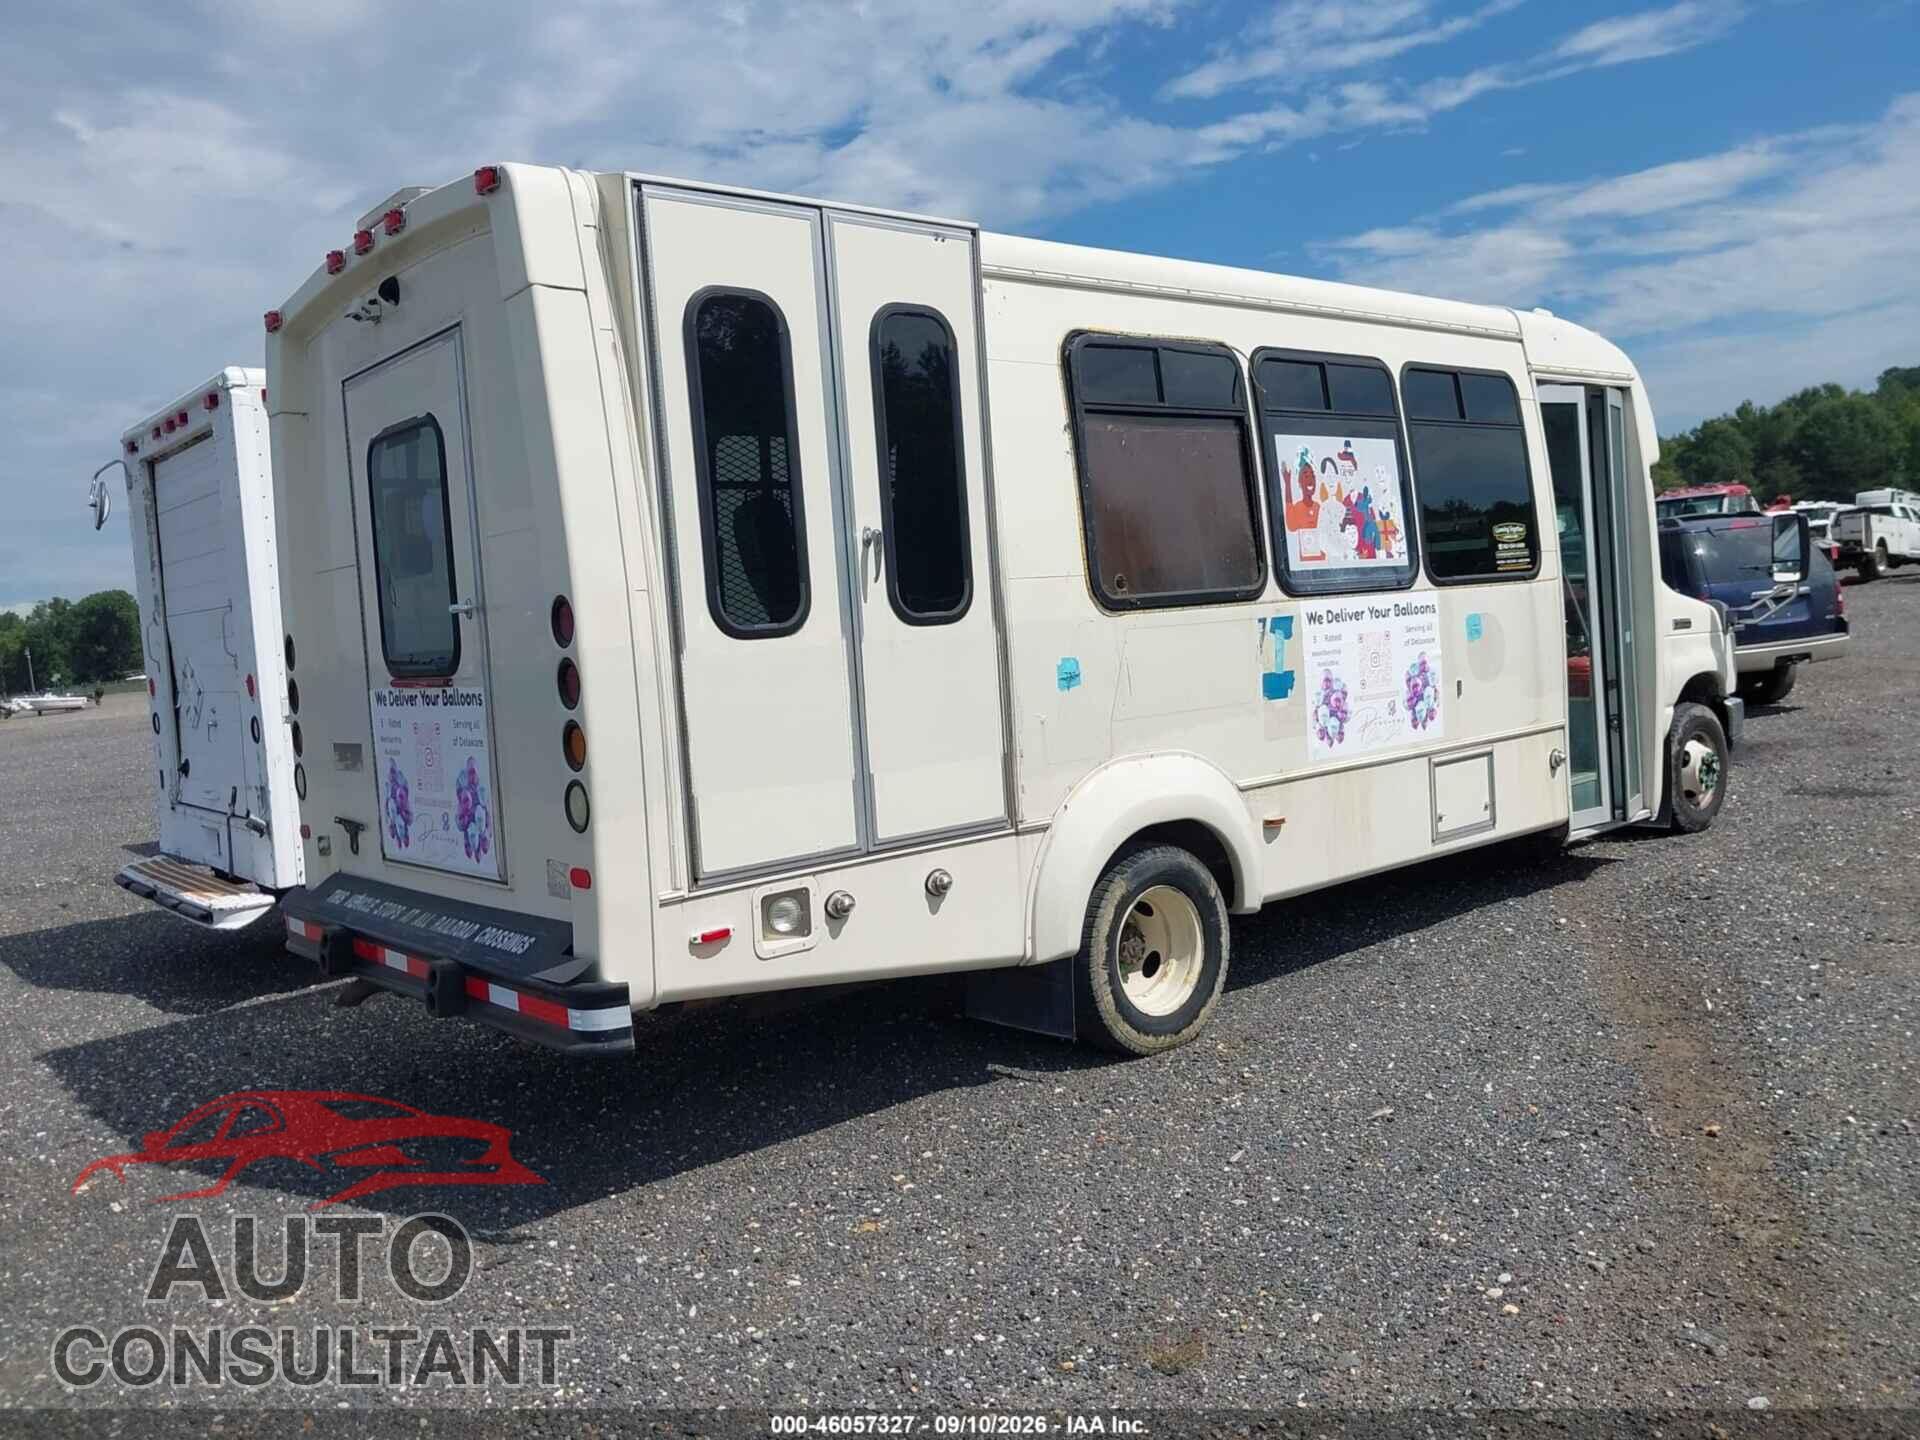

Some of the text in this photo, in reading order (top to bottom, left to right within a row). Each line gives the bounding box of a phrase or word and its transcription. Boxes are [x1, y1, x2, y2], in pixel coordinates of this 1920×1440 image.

[1306, 601, 1436, 625] We Deliver Your Balloons
[375, 688, 483, 707] We Deliver Your Balloons
[474, 926, 536, 955] CROSSINGS
